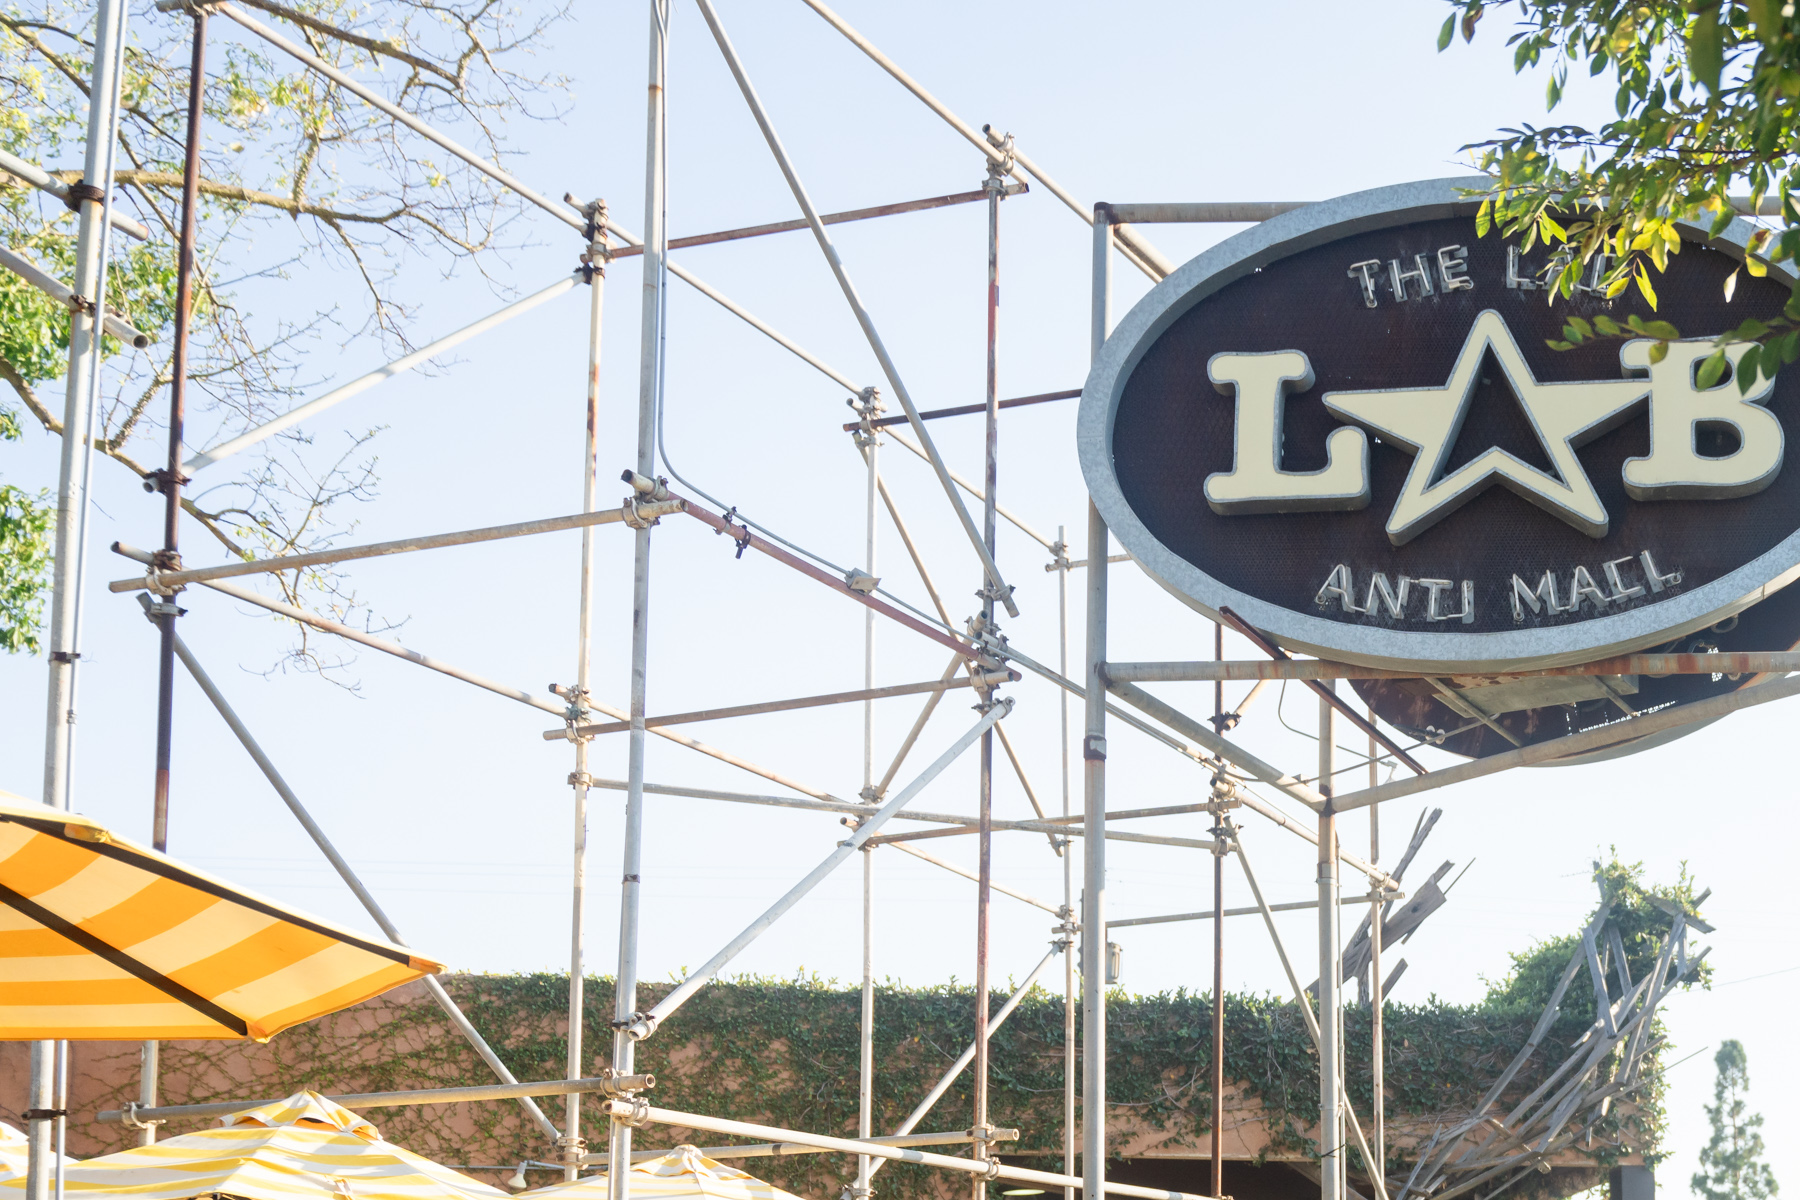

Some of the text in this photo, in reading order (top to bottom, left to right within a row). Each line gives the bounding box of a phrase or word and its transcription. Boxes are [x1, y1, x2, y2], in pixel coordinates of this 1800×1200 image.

[1347, 244, 1474, 309] THE
[1315, 549, 1683, 624] ANTI MALL
